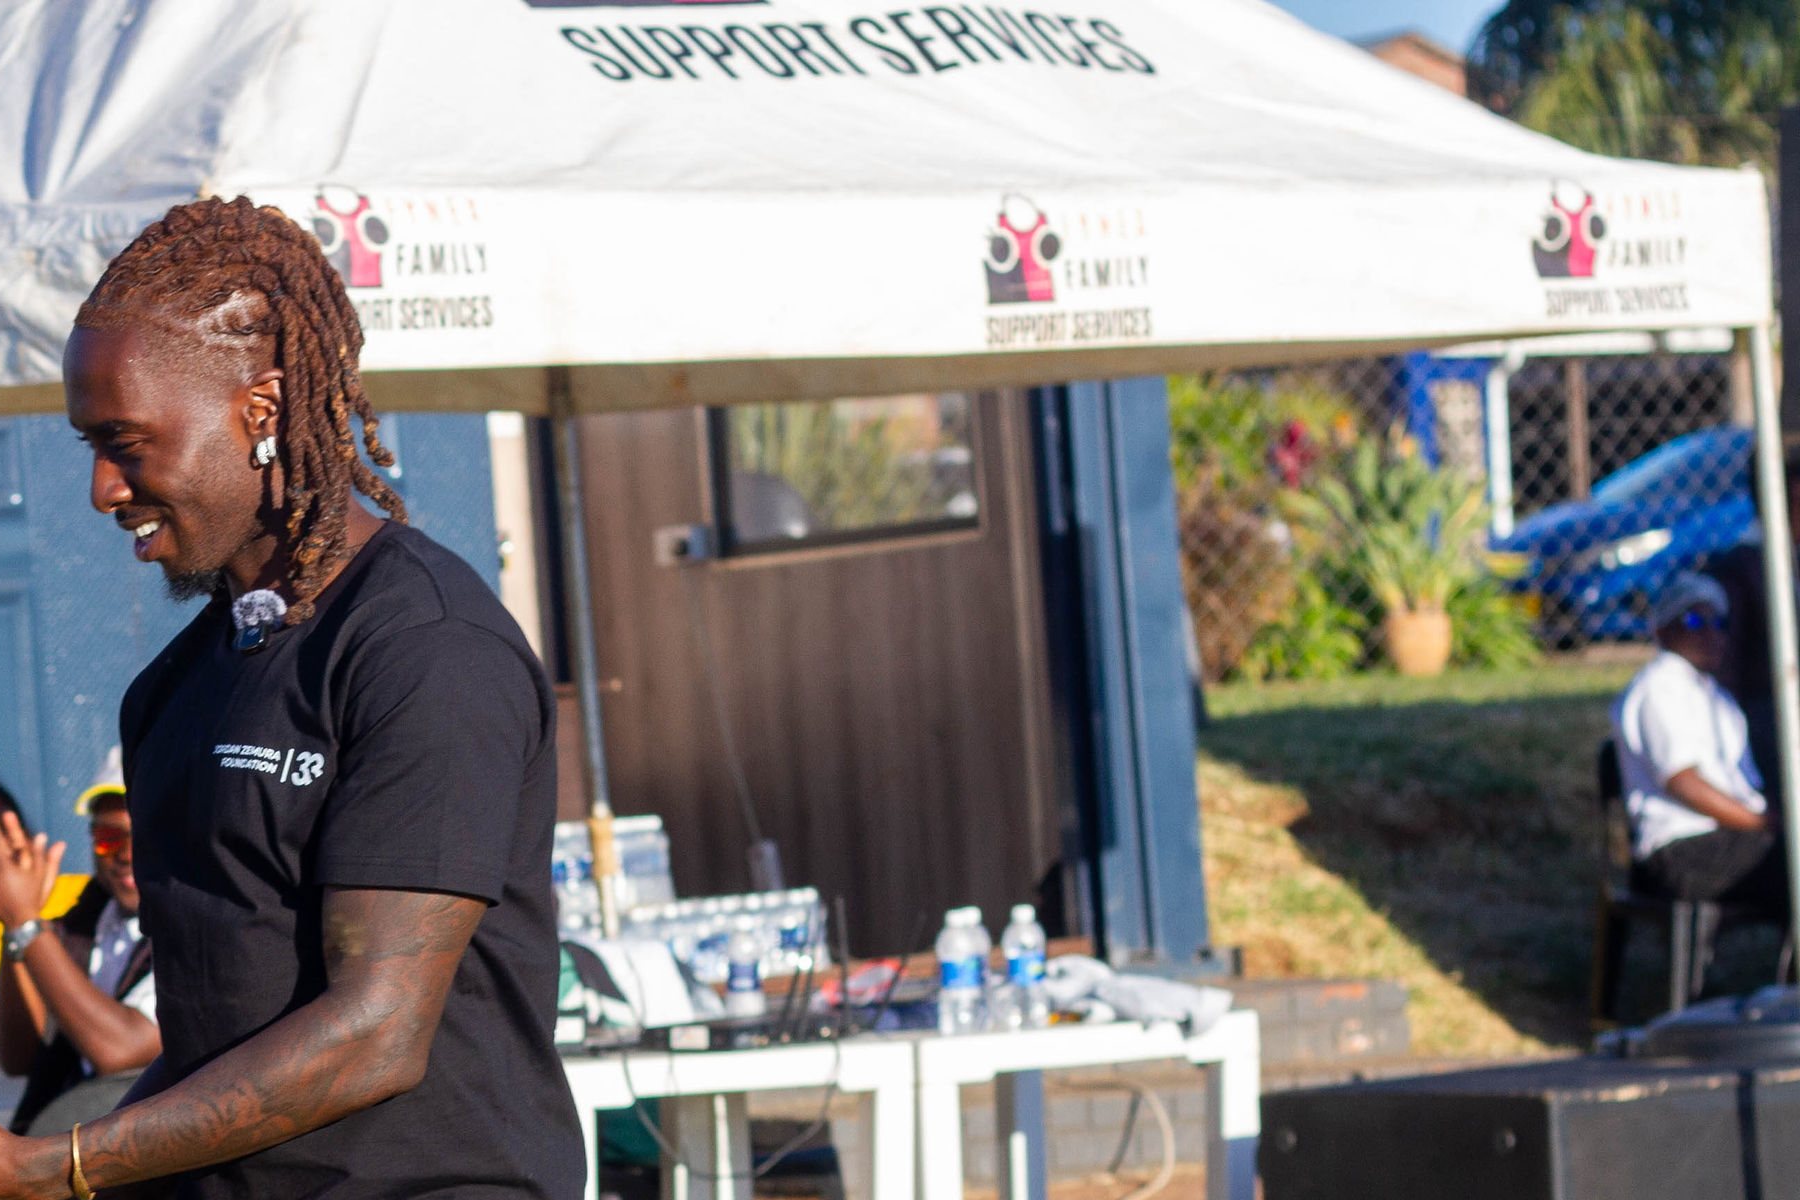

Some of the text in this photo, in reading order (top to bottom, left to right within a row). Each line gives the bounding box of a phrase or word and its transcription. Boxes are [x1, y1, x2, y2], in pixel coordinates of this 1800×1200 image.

[561, 3, 1160, 82] SUPPORT SERVICES
[396, 243, 487, 275] FAMILY
[1607, 236, 1687, 267] FAMILY
[1064, 256, 1149, 289] FAMILY
[399, 295, 494, 330] SERVICES
[985, 306, 1153, 345] SUPPORT SERVICES
[220, 757, 278, 774] FOUNDATION
[240, 745, 281, 761] ZEMURA
